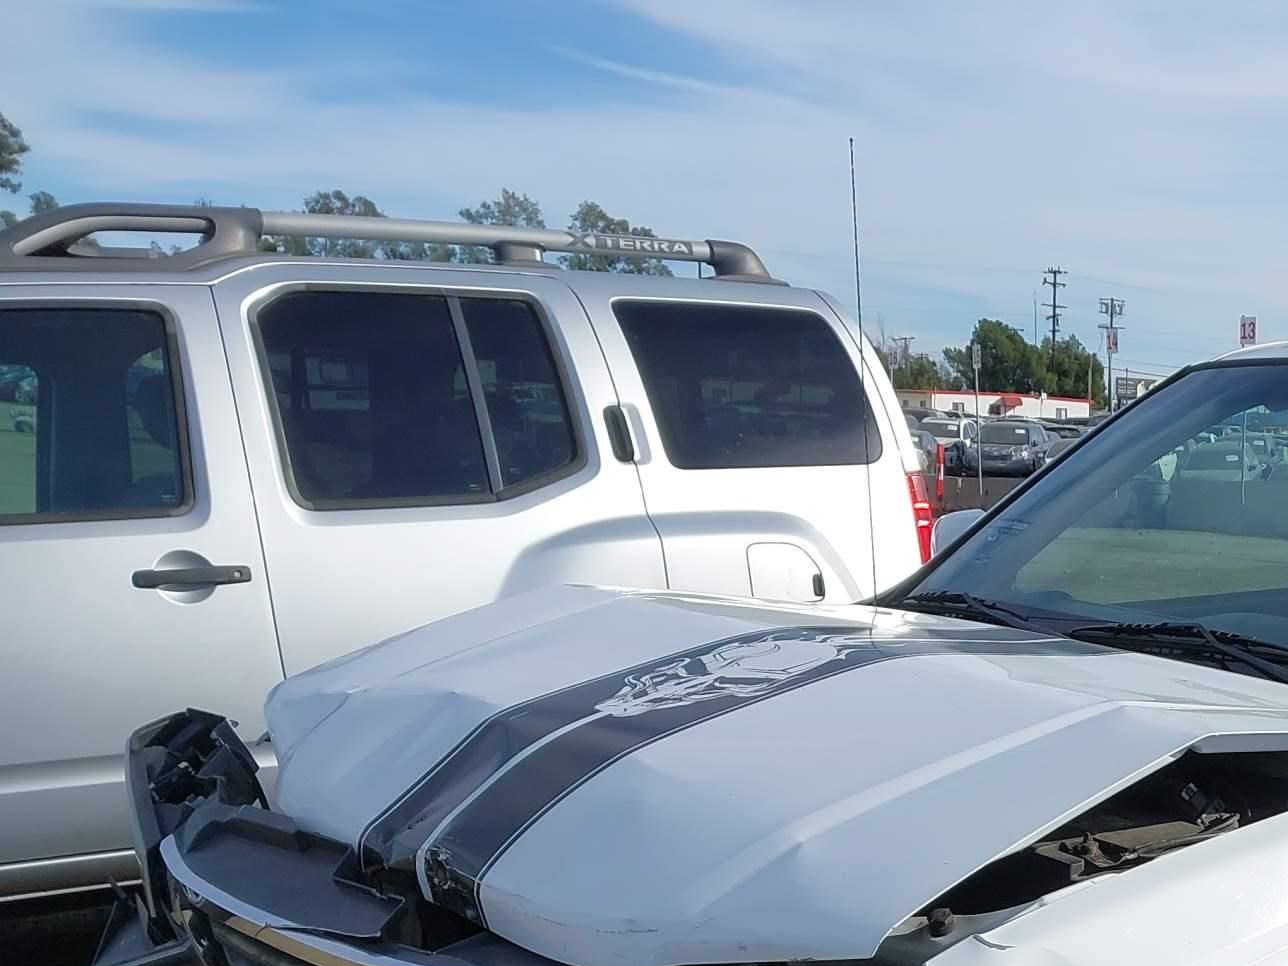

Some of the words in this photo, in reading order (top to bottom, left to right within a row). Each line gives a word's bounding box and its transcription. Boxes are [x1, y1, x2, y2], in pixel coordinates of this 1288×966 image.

[563, 230, 691, 254] XTERRA
[1240, 321, 1256, 340] 13
[1107, 332, 1118, 350] 14
